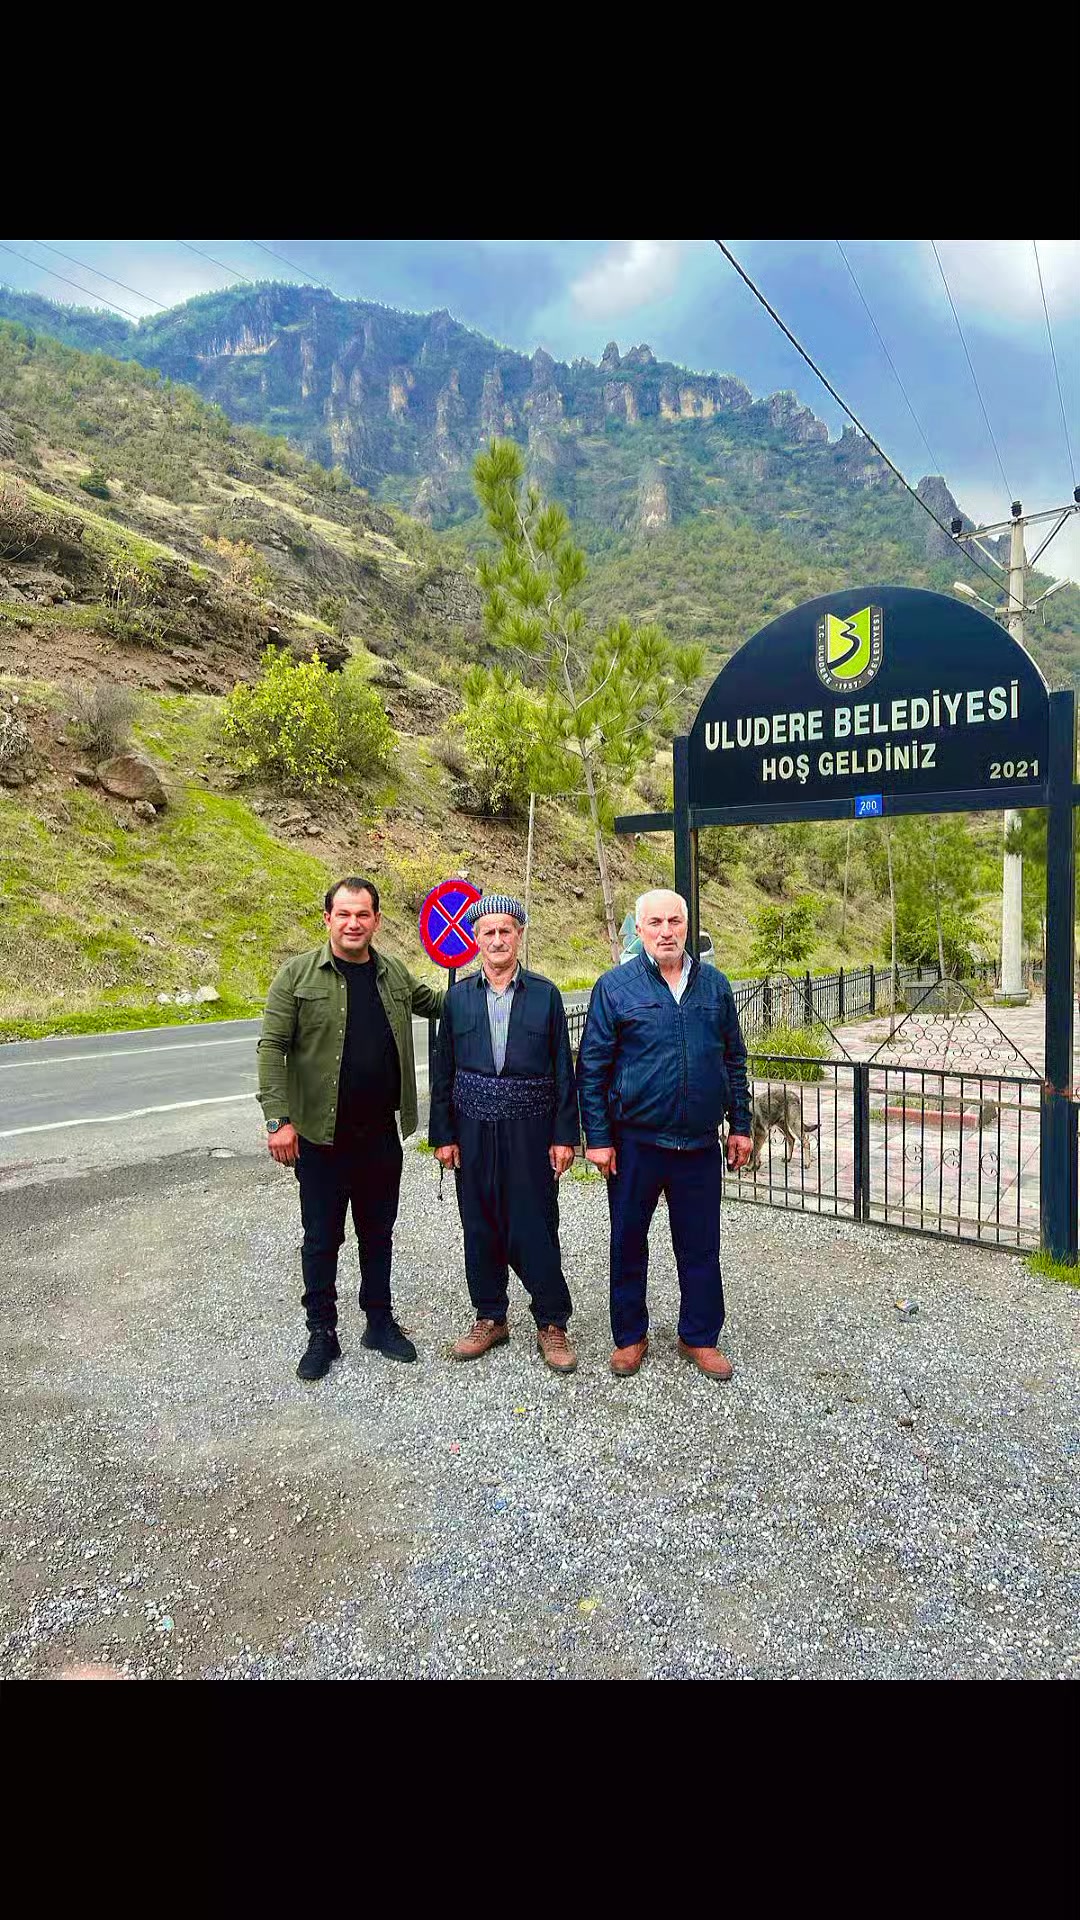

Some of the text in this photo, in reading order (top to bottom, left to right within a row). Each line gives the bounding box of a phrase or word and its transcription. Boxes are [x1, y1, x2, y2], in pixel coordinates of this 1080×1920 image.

[818, 645, 832, 684] ULUDERE
[704, 680, 1020, 751] ULUDERE BELEDİYESİ
[762, 740, 936, 784] HOŞ GELDİNİZ
[989, 760, 1039, 779] 2021
